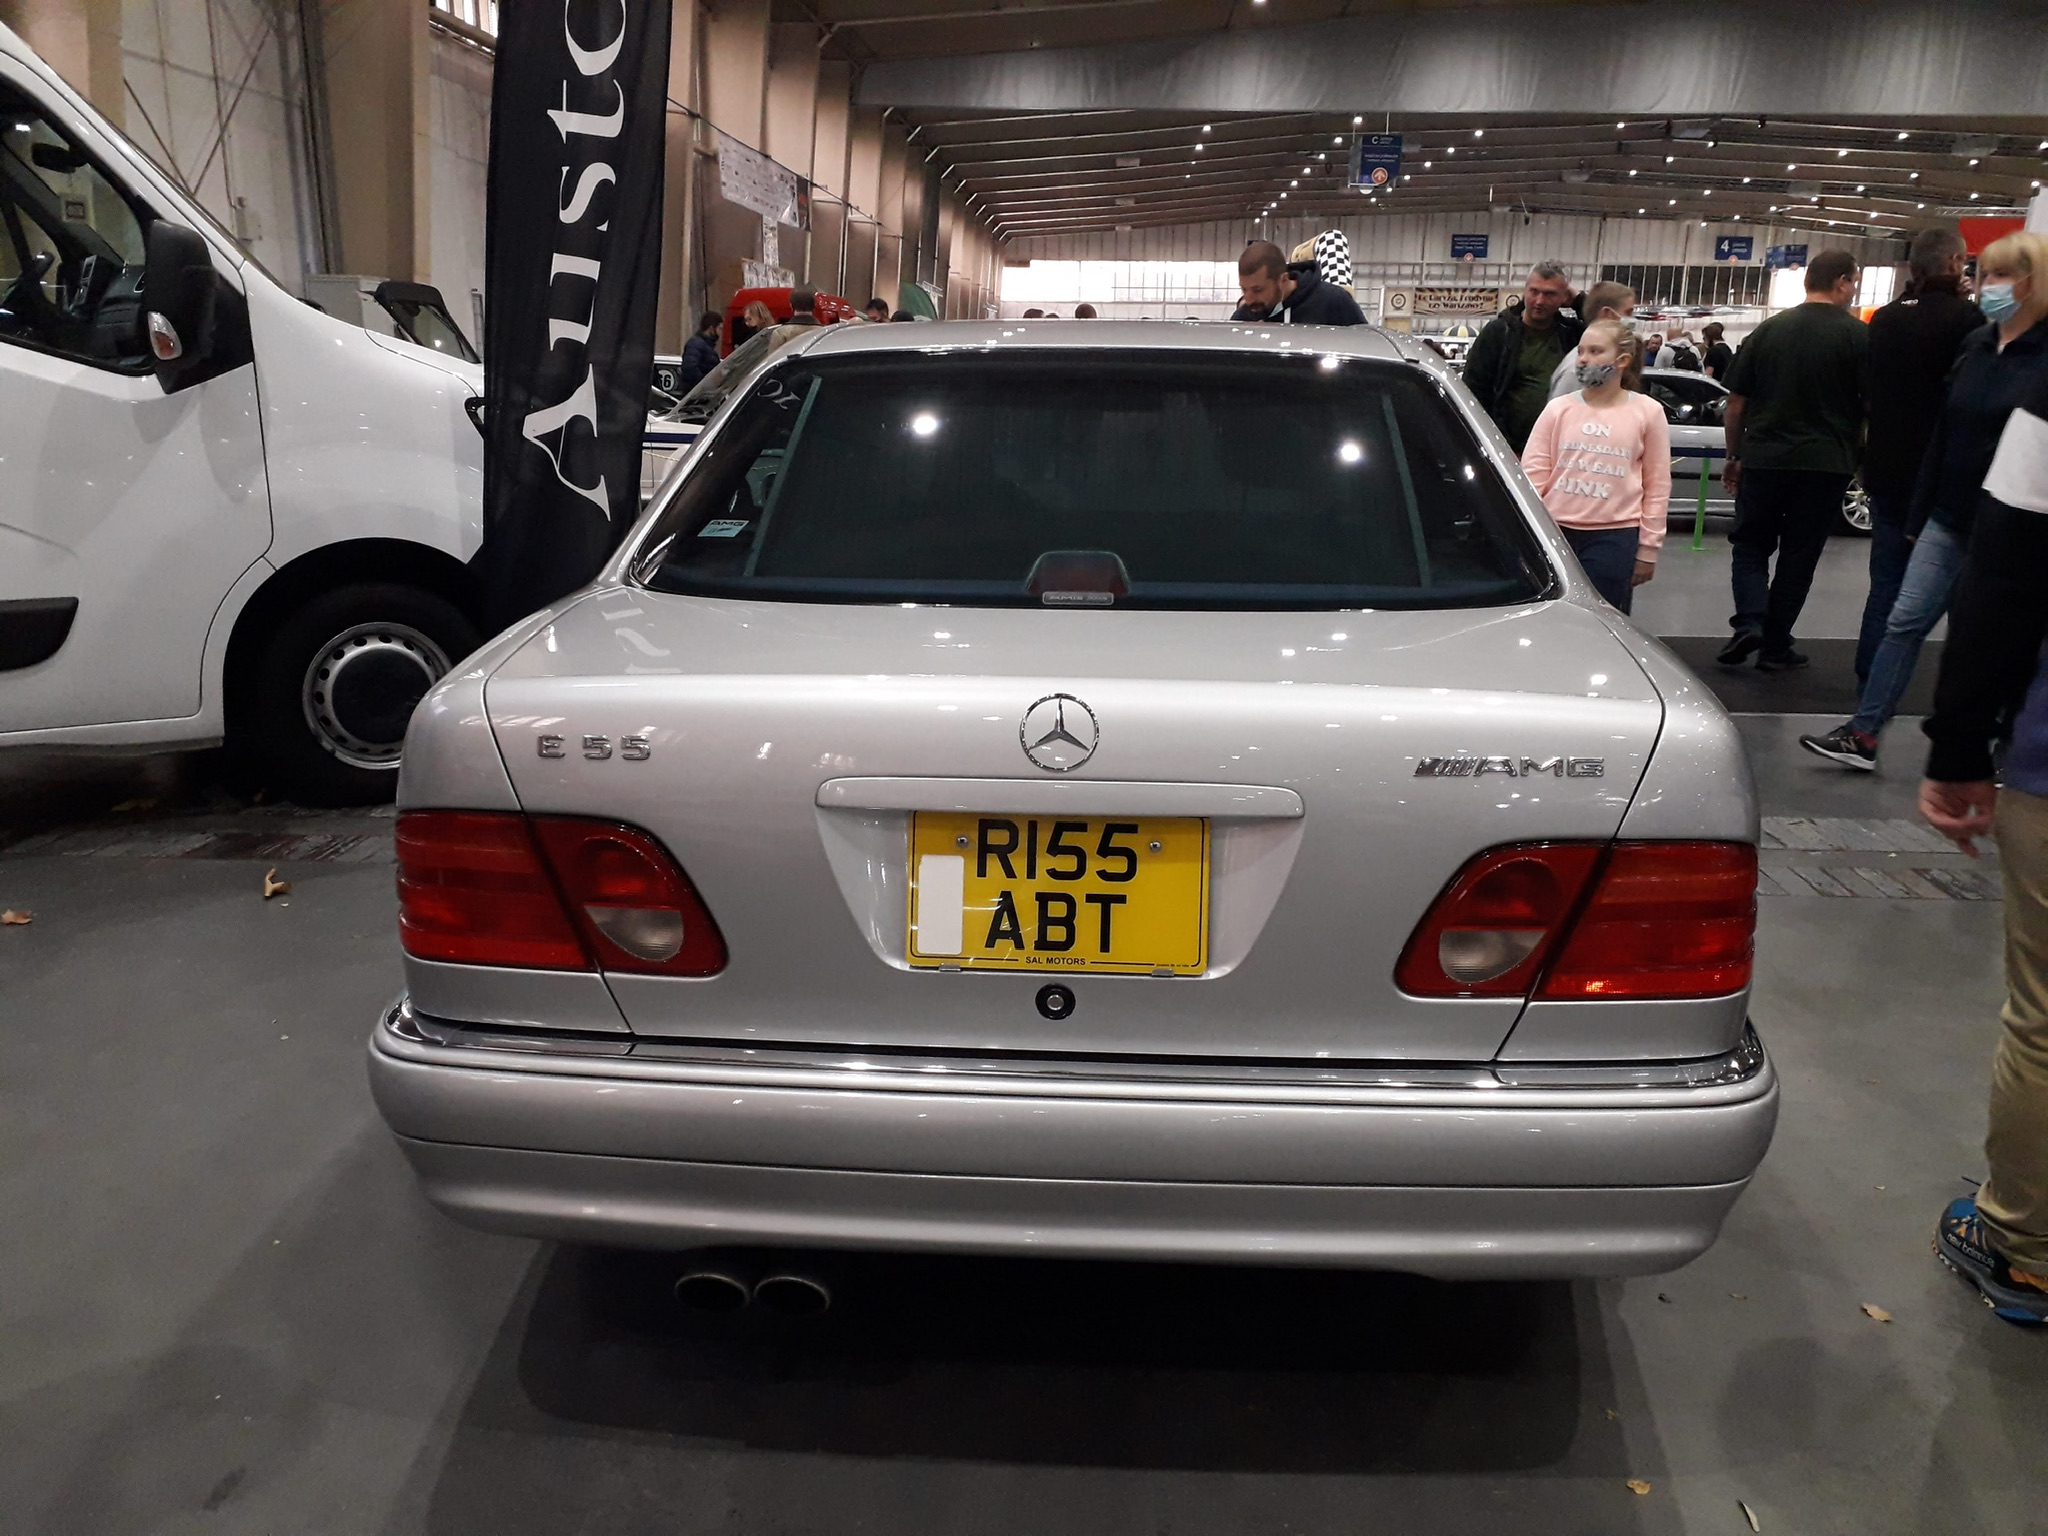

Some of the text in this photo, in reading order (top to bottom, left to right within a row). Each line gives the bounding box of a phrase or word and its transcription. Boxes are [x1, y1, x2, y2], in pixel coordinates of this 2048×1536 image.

[1371, 135, 1380, 145] C
[1720, 239, 1730, 253] 4
[1581, 422, 1613, 438] ON
[1577, 458, 1626, 478] WEAR
[1553, 476, 1612, 500] PINK
[536, 734, 652, 760] E 55
[1472, 755, 1606, 778] AMG
[976, 818, 1139, 882] R155
[984, 890, 1127, 953] ABT
[1025, 956, 1086, 966] SAL MOTORS
